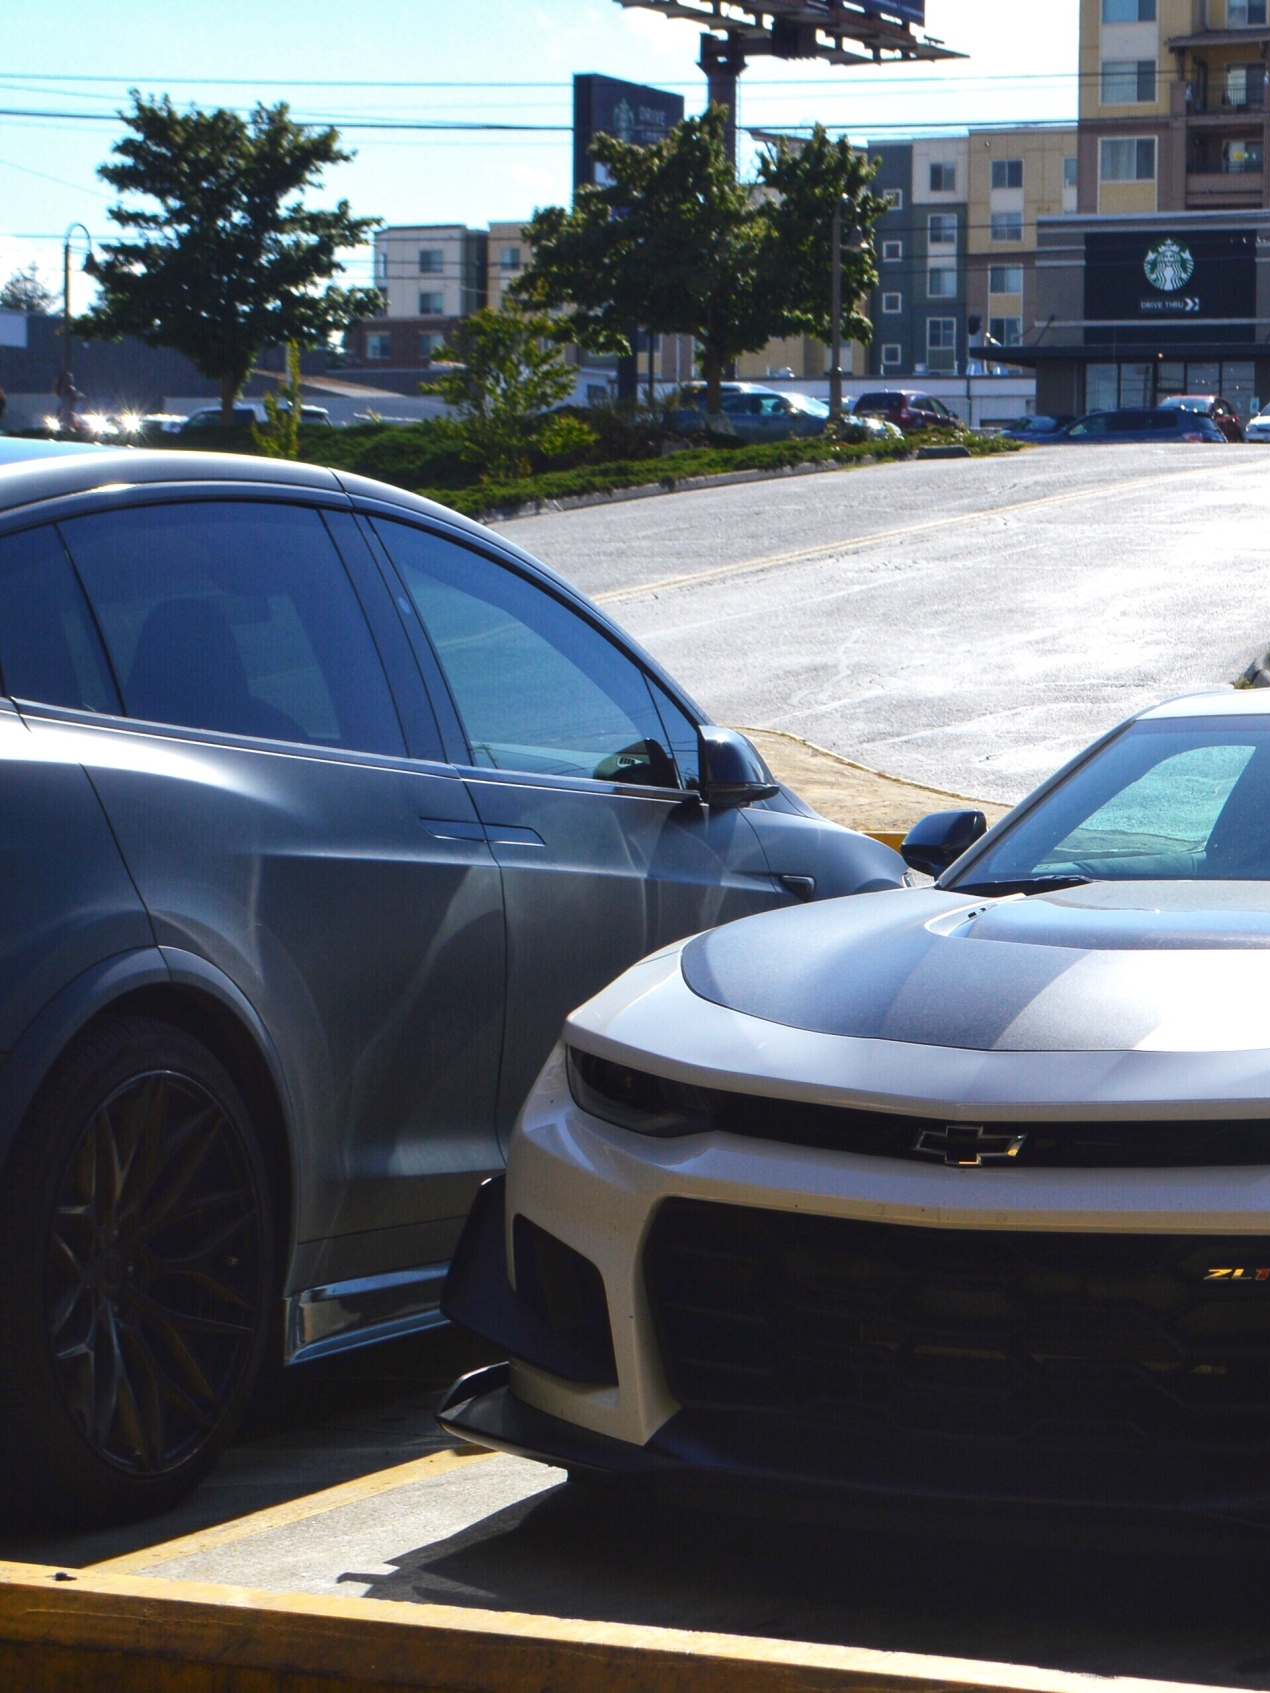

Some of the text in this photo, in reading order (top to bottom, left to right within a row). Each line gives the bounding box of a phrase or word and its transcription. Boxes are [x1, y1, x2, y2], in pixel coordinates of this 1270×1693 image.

[1141, 301, 1184, 309] DRIVE THRU
[1203, 1268, 1270, 1280] ZL1
